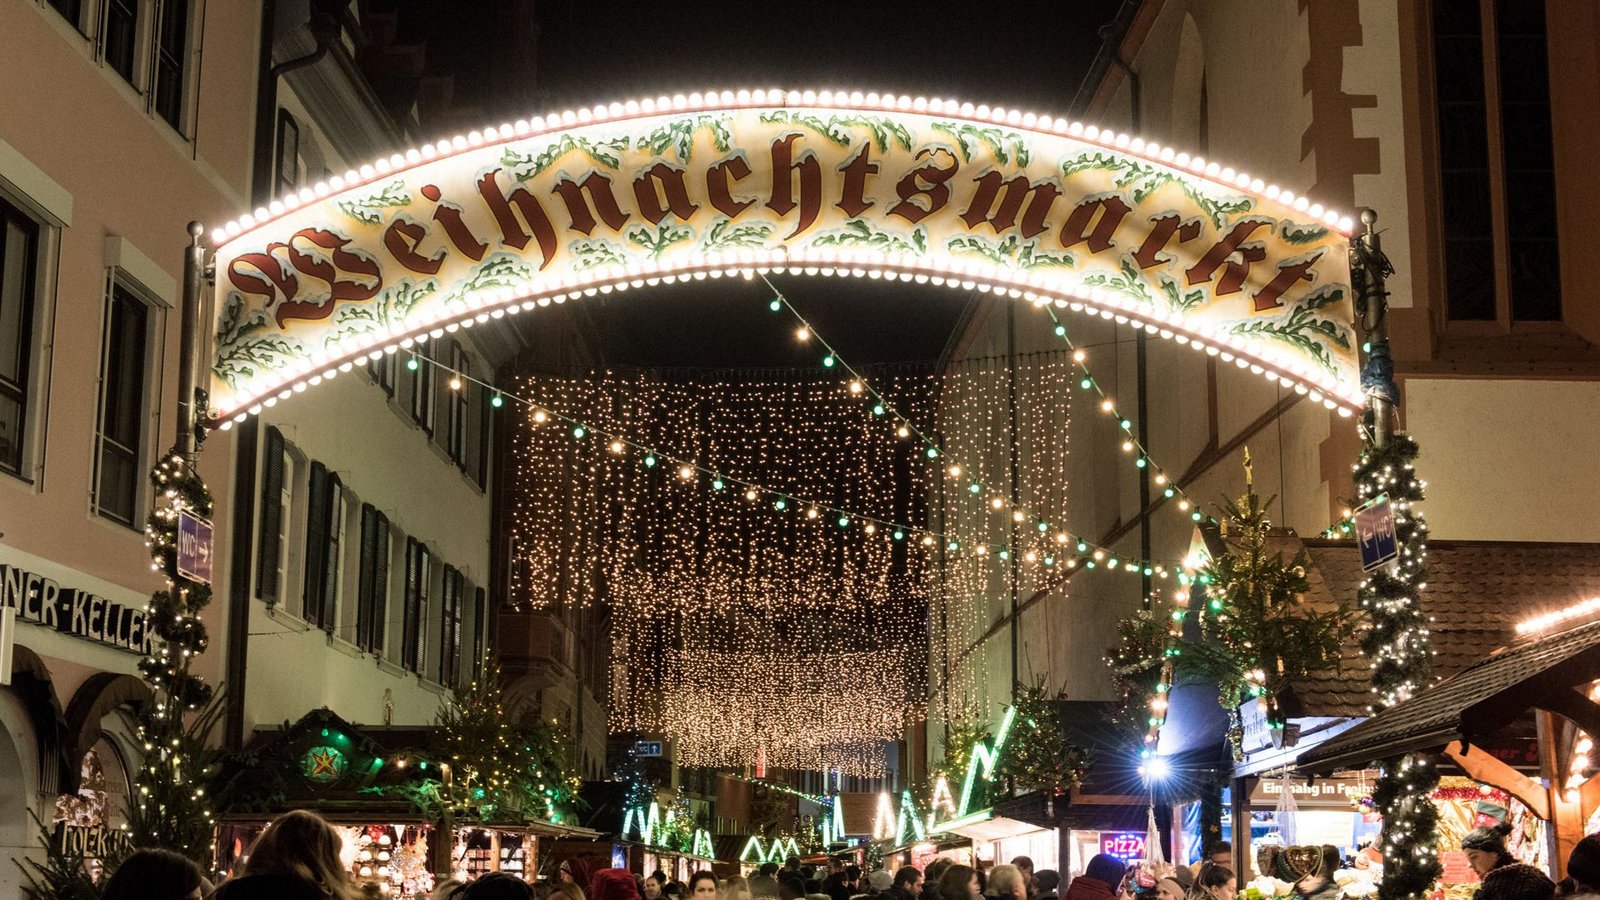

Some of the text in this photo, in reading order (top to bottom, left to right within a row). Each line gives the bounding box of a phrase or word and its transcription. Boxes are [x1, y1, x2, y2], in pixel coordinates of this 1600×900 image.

[228, 133, 1319, 329] Weihnachtsmarkt
[182, 530, 196, 557] WC
[0, 564, 155, 655] NER-KELLER
[1322, 782, 1335, 794] in
[1104, 840, 1146, 853] PIZZA
